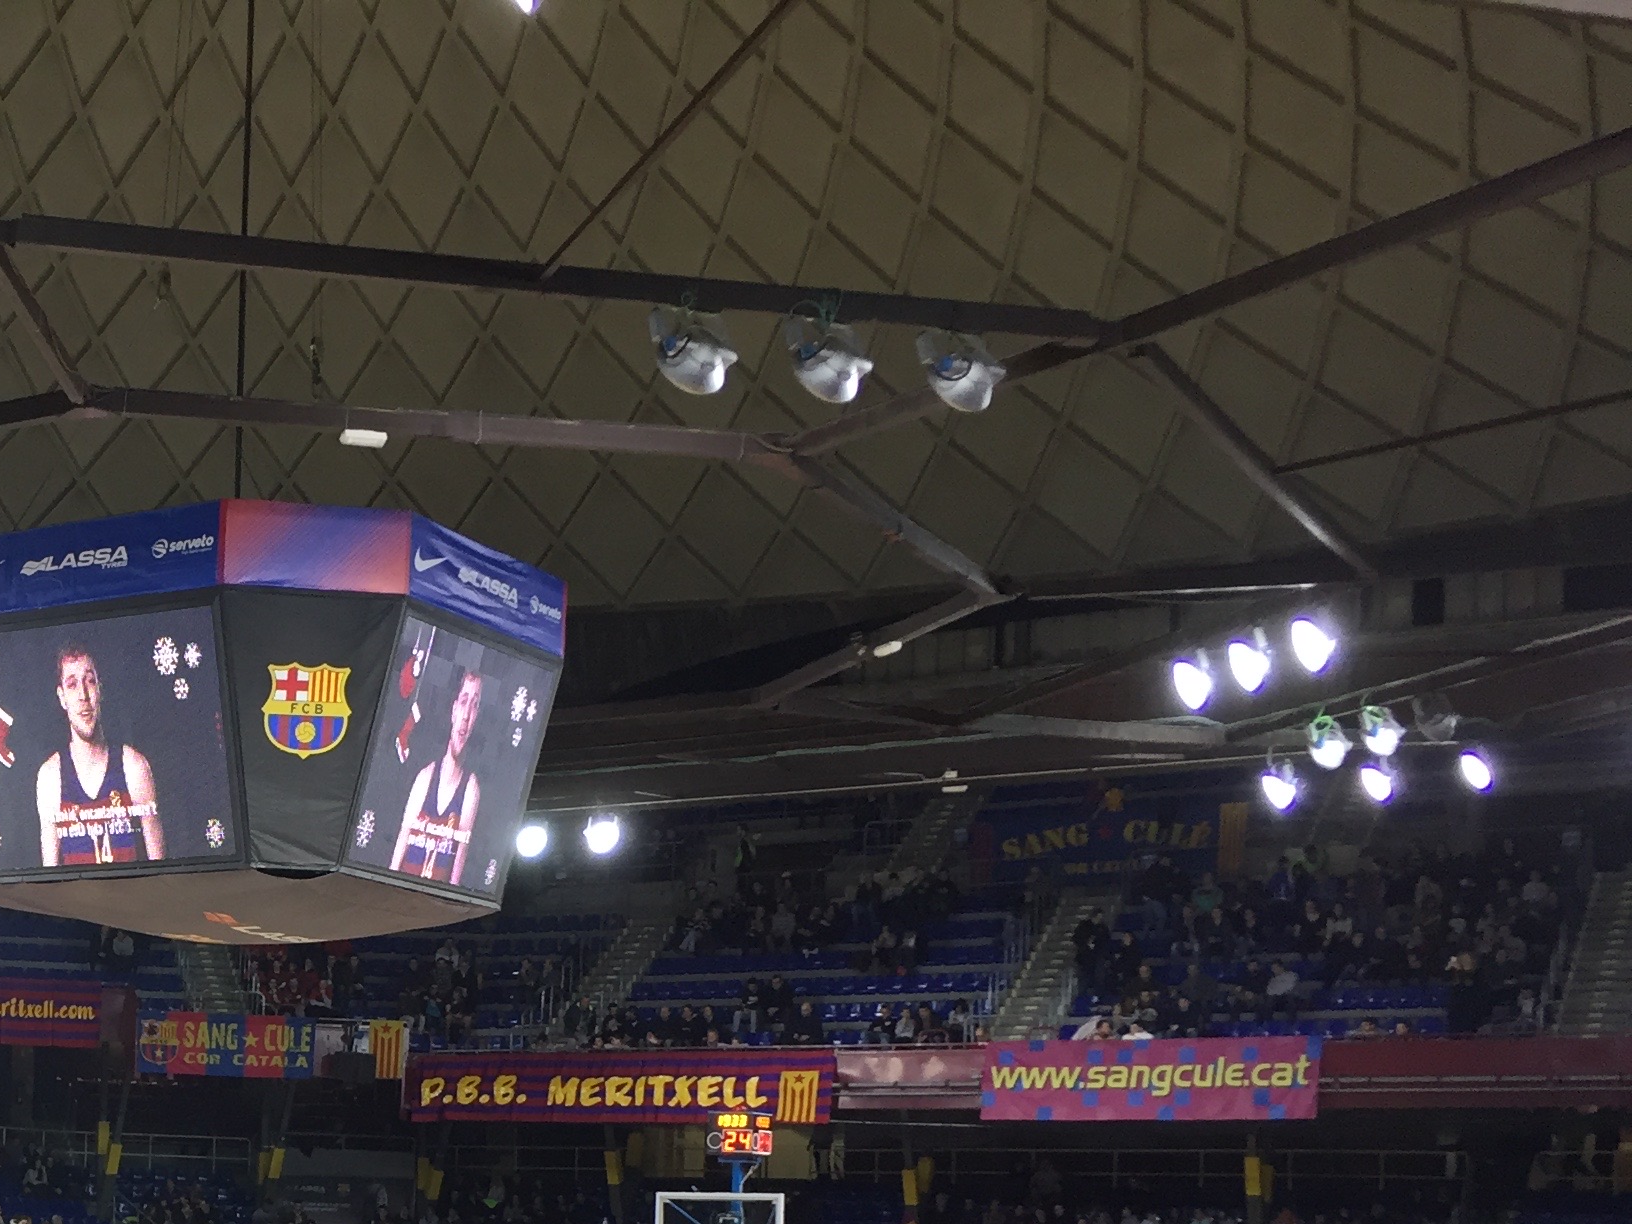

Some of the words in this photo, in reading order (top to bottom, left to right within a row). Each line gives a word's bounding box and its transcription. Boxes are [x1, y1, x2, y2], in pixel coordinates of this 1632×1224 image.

[168, 534, 215, 553] serveto
[44, 546, 129, 571] LASSA
[471, 570, 518, 604] LASSA
[1001, 823, 1090, 861] SANG
[182, 1021, 238, 1050] SANG
[183, 1052, 220, 1066] COR
[991, 1054, 1311, 1097] www.sangcule.cat
[421, 1074, 527, 1108] P.B.B.
[547, 1075, 768, 1108] MERITXELL
[724, 1131, 752, 1152] 24
